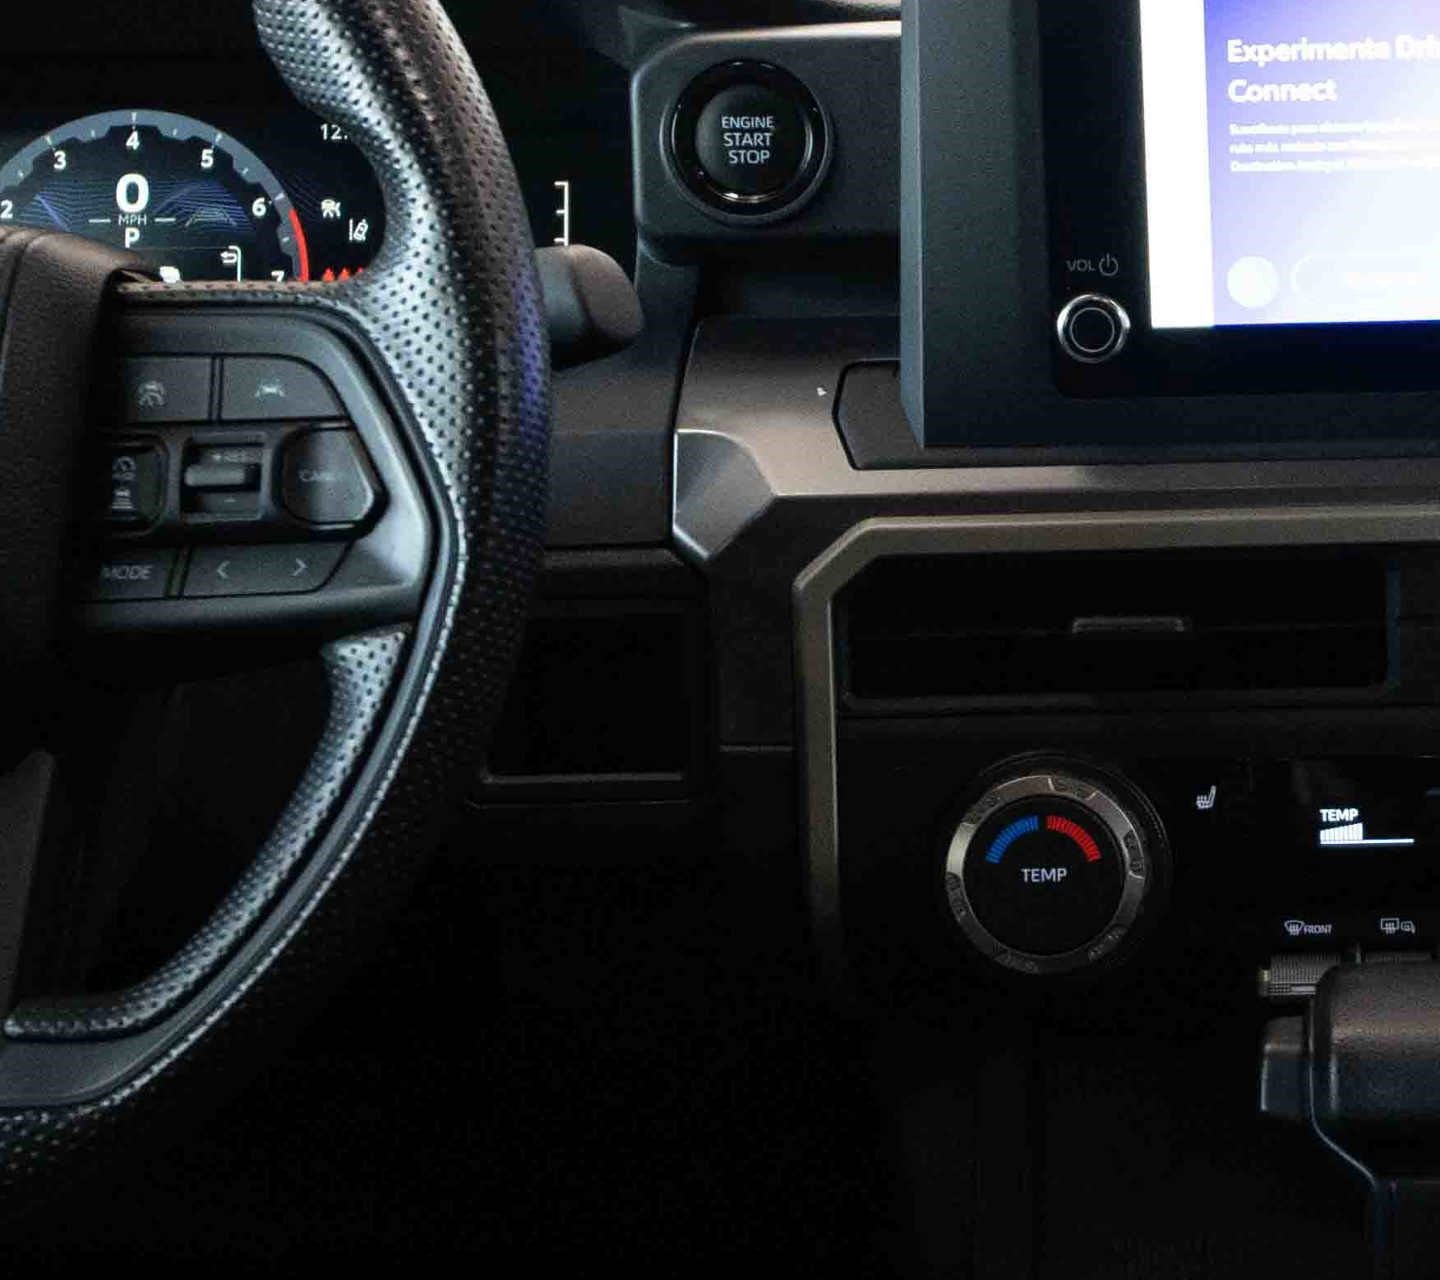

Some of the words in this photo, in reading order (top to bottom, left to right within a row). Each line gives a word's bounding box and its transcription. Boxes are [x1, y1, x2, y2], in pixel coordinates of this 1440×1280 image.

[1228, 79, 1337, 103] Connect
[720, 116, 775, 129] ENGINE
[125, 131, 140, 151] 4
[722, 132, 773, 147] START
[53, 150, 67, 170] 3
[200, 149, 214, 169] 5
[727, 149, 771, 165] STOP
[115, 172, 149, 214] 0
[0, 199, 13, 220] 2
[251, 197, 266, 217] 6
[117, 214, 148, 225] MPH
[123, 227, 140, 248] P
[1064, 258, 1097, 272] VOL
[1318, 808, 1360, 822] TEMP
[1021, 867, 1069, 883] TEMP
[1303, 923, 1333, 935] FRONT
